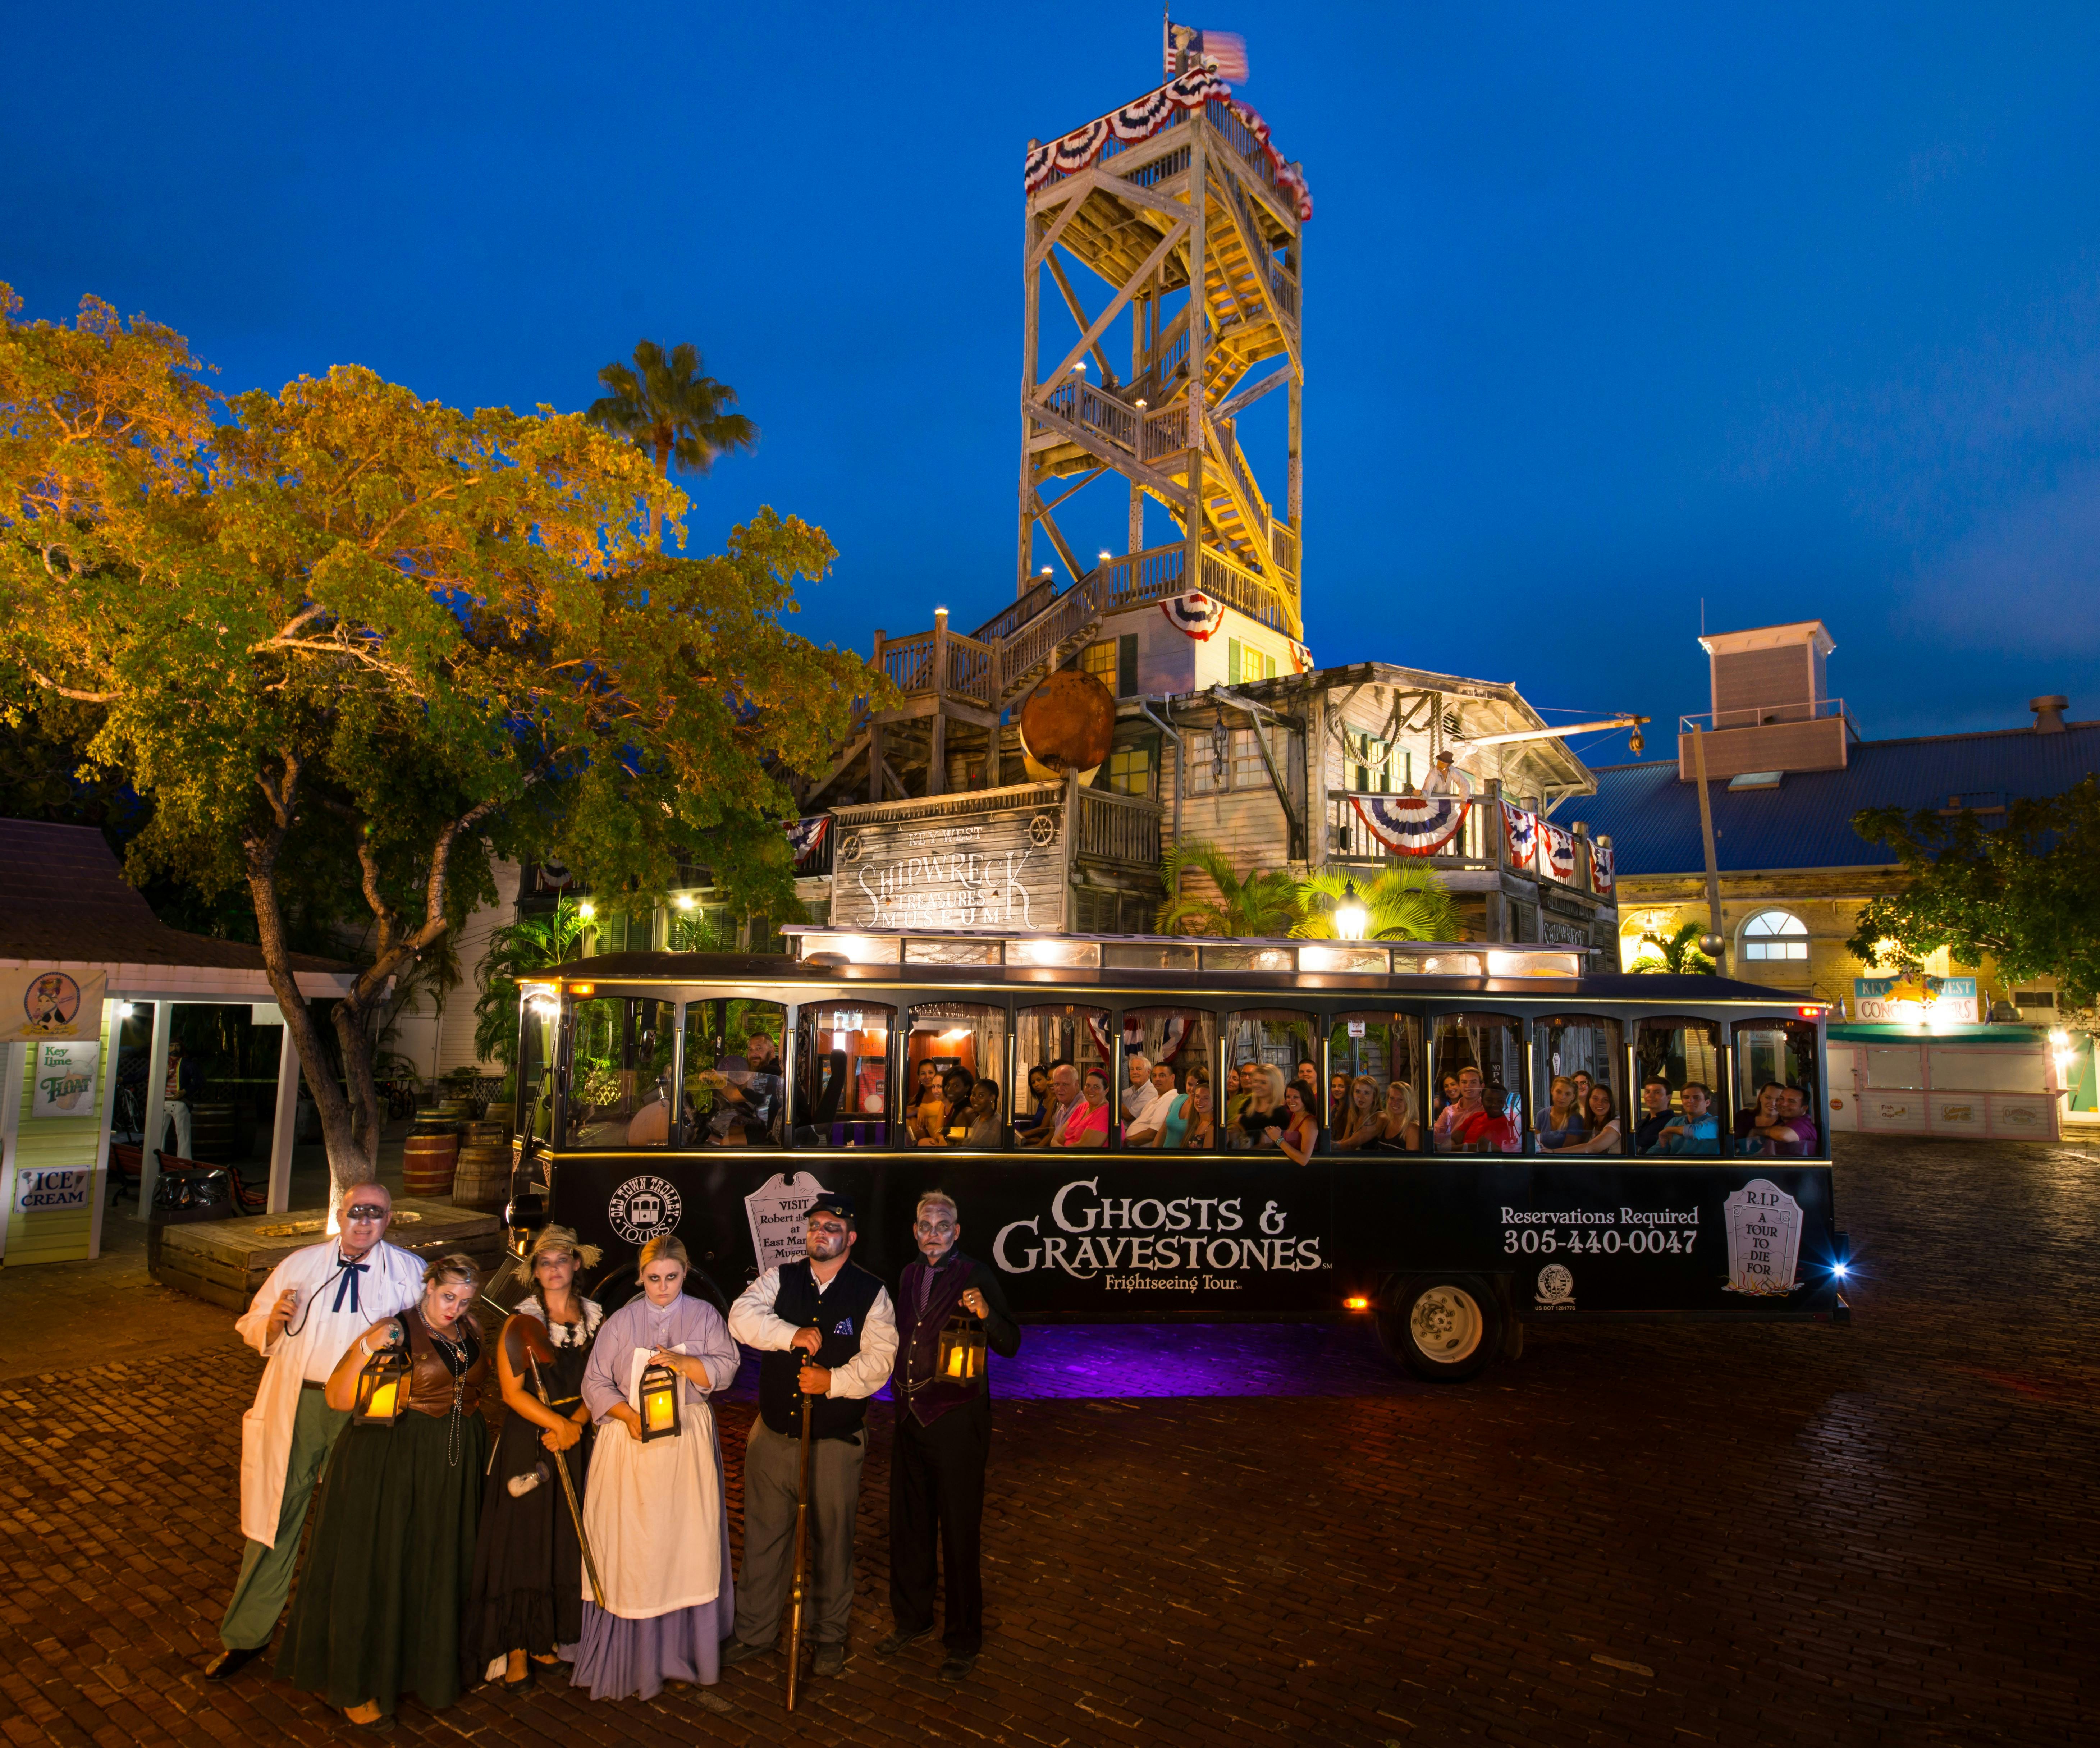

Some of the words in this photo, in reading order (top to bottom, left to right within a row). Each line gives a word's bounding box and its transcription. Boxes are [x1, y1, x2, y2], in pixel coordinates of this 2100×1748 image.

[908, 831, 939, 846] KEY
[942, 826, 983, 843] WEST
[856, 851, 1039, 929] SHIPWRECK
[896, 888, 986, 910] TREASURES
[880, 907, 1001, 928] MUSEUM
[1862, 982, 1886, 994] KEY
[45, 1046, 69, 1057] Key
[44, 1057, 72, 1067] Lime
[40, 1076, 92, 1104] FLOAT
[35, 1171, 74, 1191] ICE
[617, 1177, 646, 1199] TOWN
[21, 1191, 84, 1207] CREAM
[650, 1178, 680, 1217] TROLLEY
[779, 1199, 809, 1210] VISIT
[1051, 1176, 1243, 1233] GHOSTS
[1259, 1200, 1287, 1235] &
[1747, 1191, 1779, 1206] R.I.P
[611, 1199, 624, 1217] OLD
[760, 1213, 793, 1224] Robert
[1500, 1207, 1615, 1224] Reservations
[1620, 1206, 1699, 1228] Required
[1758, 1213, 1767, 1223] A
[619, 1222, 670, 1243] TOURS
[1746, 1223, 1778, 1237] TOUR
[763, 1238, 784, 1247] East
[992, 1214, 1322, 1280] GRAVESTONES
[1504, 1228, 1697, 1253] 305-440-0047
[1753, 1237, 1769, 1249] TO
[775, 1249, 809, 1258] Museu
[1750, 1250, 1770, 1262] DIE
[1539, 1267, 1553, 1283] Historic
[1561, 1268, 1571, 1283] Tours
[1746, 1263, 1771, 1275] FOR
[1105, 1273, 1198, 1294] Frightseeing
[1202, 1274, 1237, 1290] Tour
